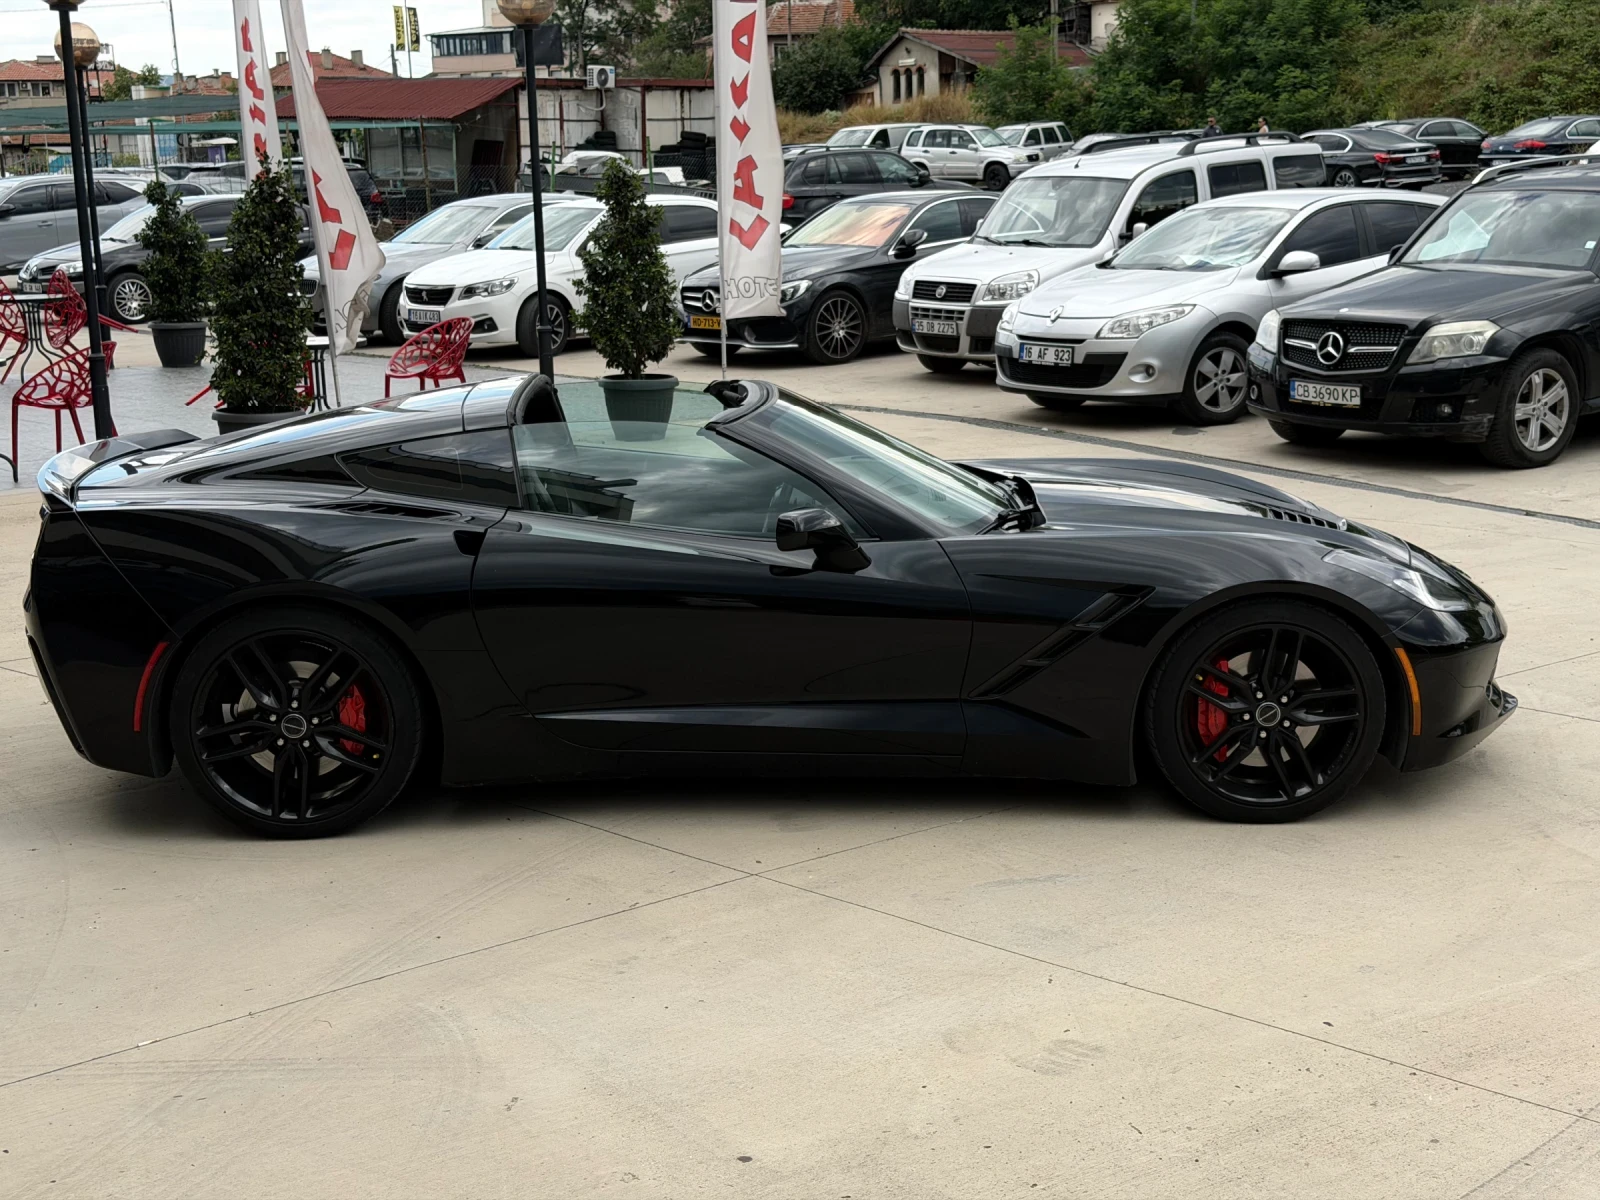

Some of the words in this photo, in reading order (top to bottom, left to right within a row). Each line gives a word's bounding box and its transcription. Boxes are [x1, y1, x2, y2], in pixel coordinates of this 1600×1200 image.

[1024, 346, 1033, 359] 16
[1037, 347, 1049, 360] AF
[1053, 348, 1071, 362] 923
